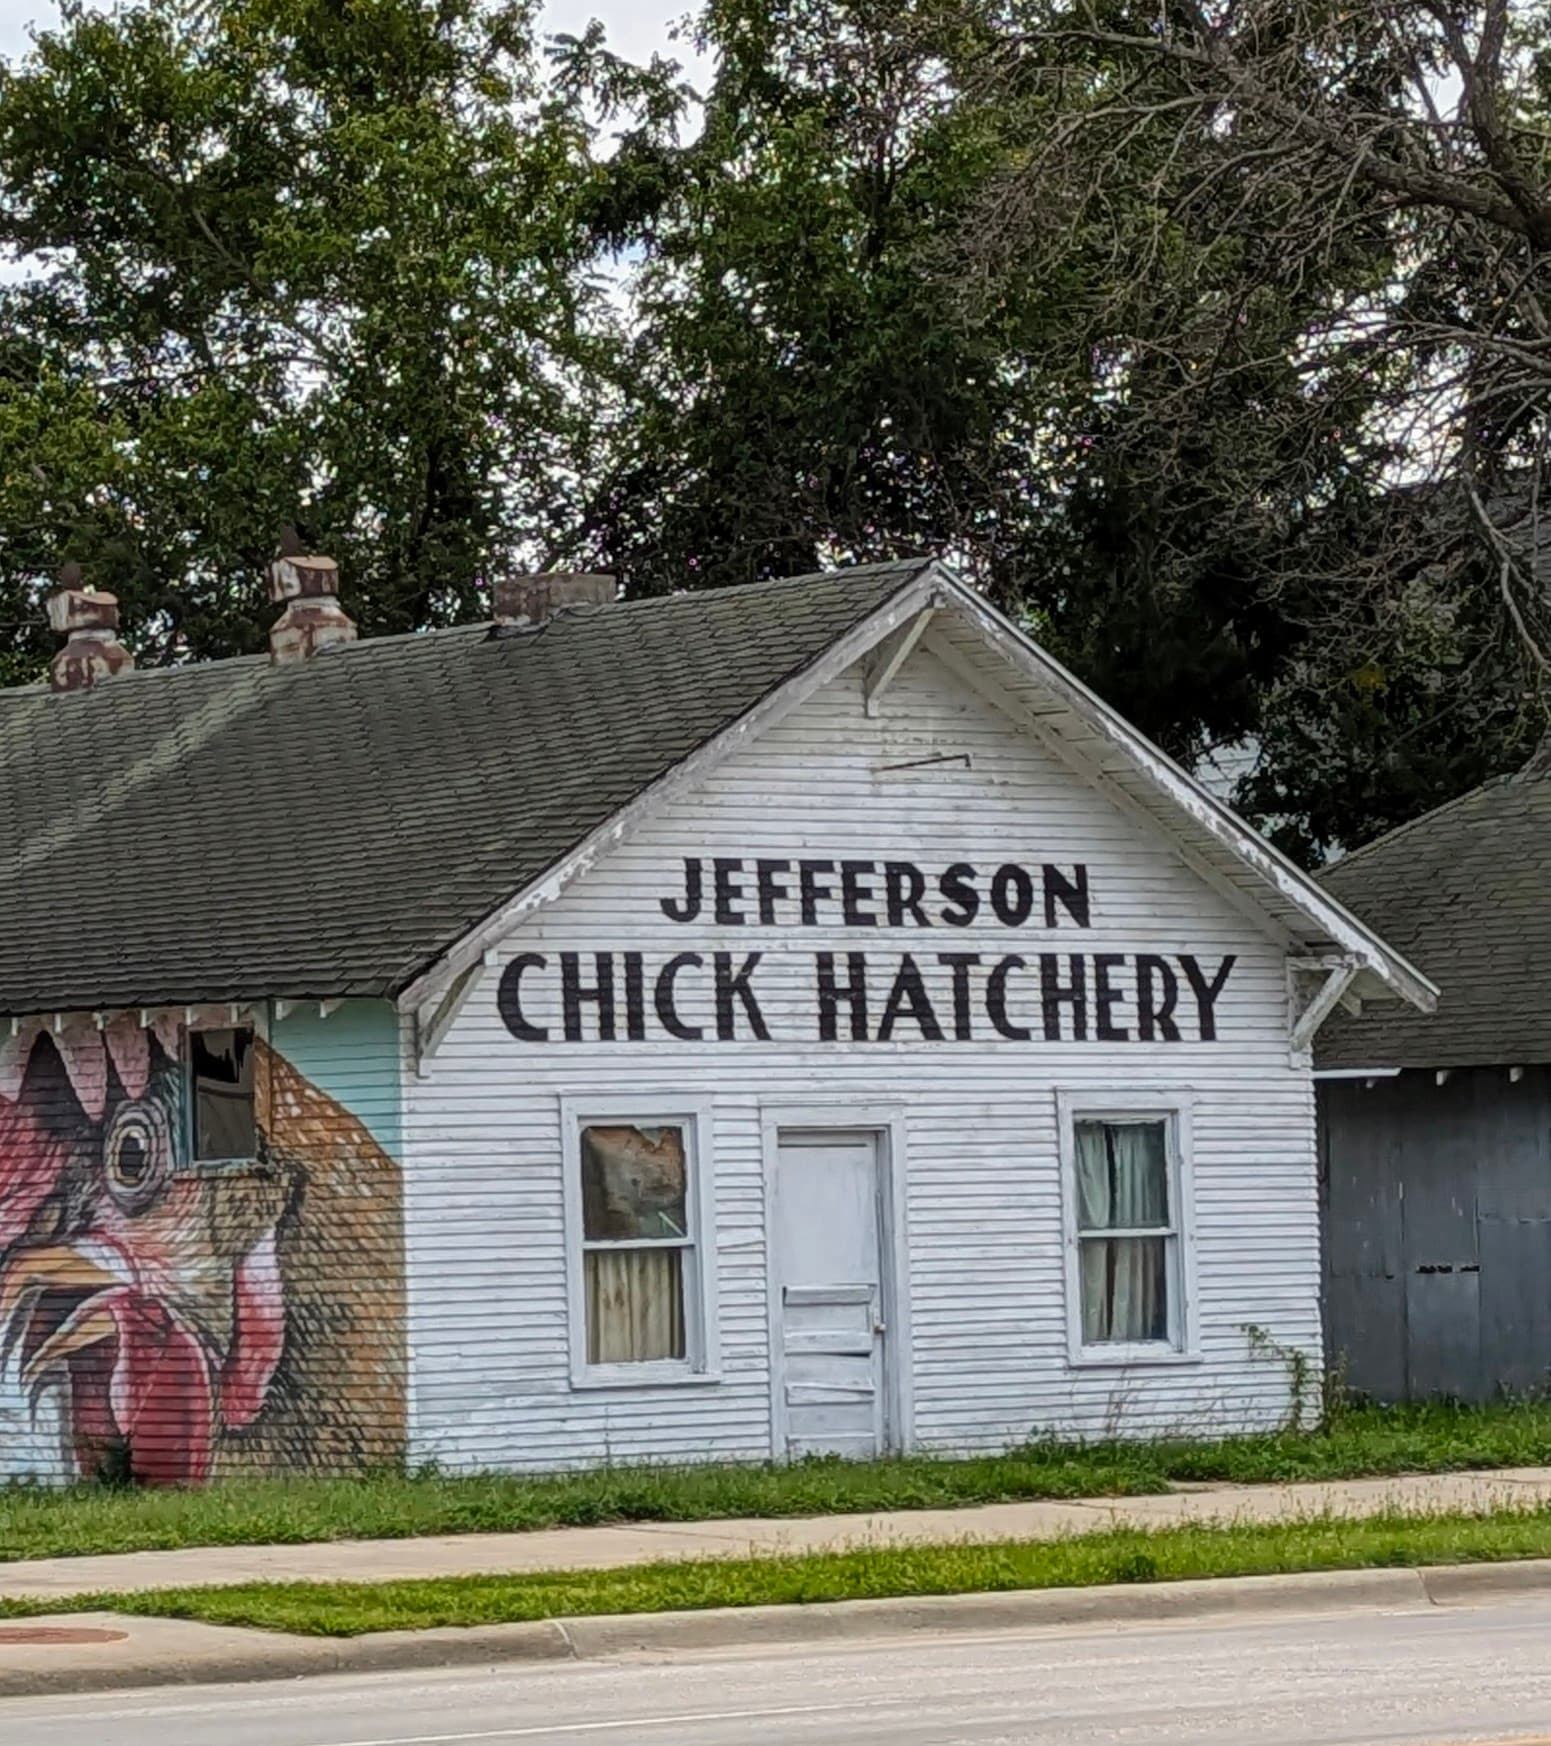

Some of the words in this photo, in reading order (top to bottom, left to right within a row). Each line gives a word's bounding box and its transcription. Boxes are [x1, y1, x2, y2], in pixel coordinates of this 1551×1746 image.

[659, 857, 1092, 929] JEFFERSON
[496, 951, 773, 1043] CHICK
[814, 951, 1239, 1043] HATCHERY
